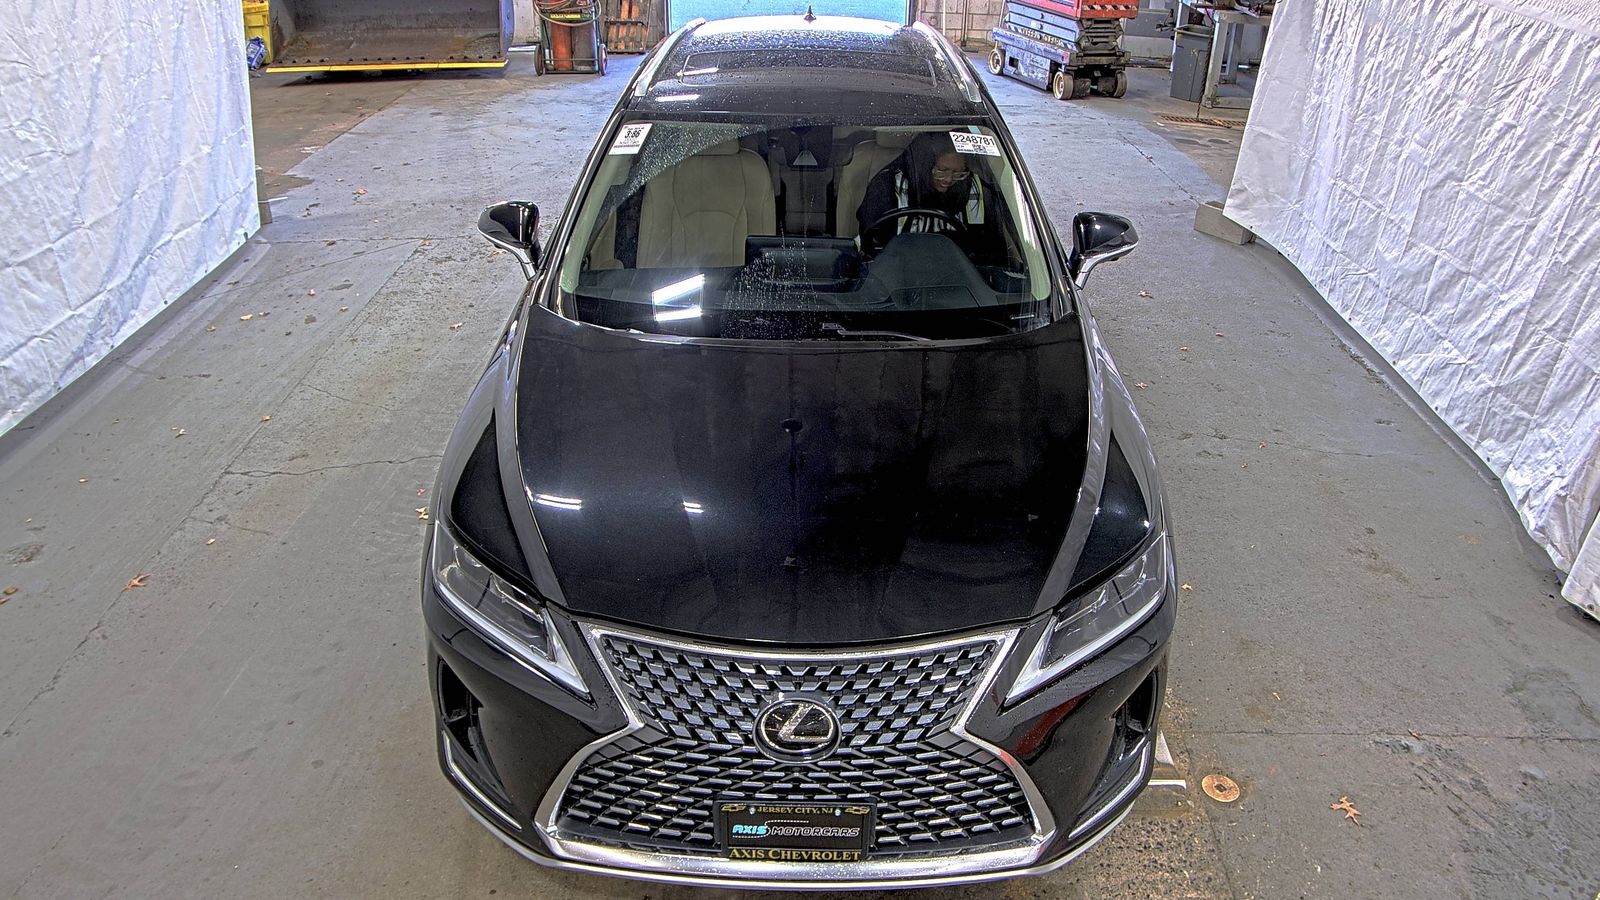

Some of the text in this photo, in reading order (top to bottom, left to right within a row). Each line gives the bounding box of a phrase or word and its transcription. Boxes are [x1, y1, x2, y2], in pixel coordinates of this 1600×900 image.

[952, 134, 995, 146] 2248781
[757, 806, 793, 814] JERSEY
[732, 824, 860, 837] AXIS MOTORCARS
